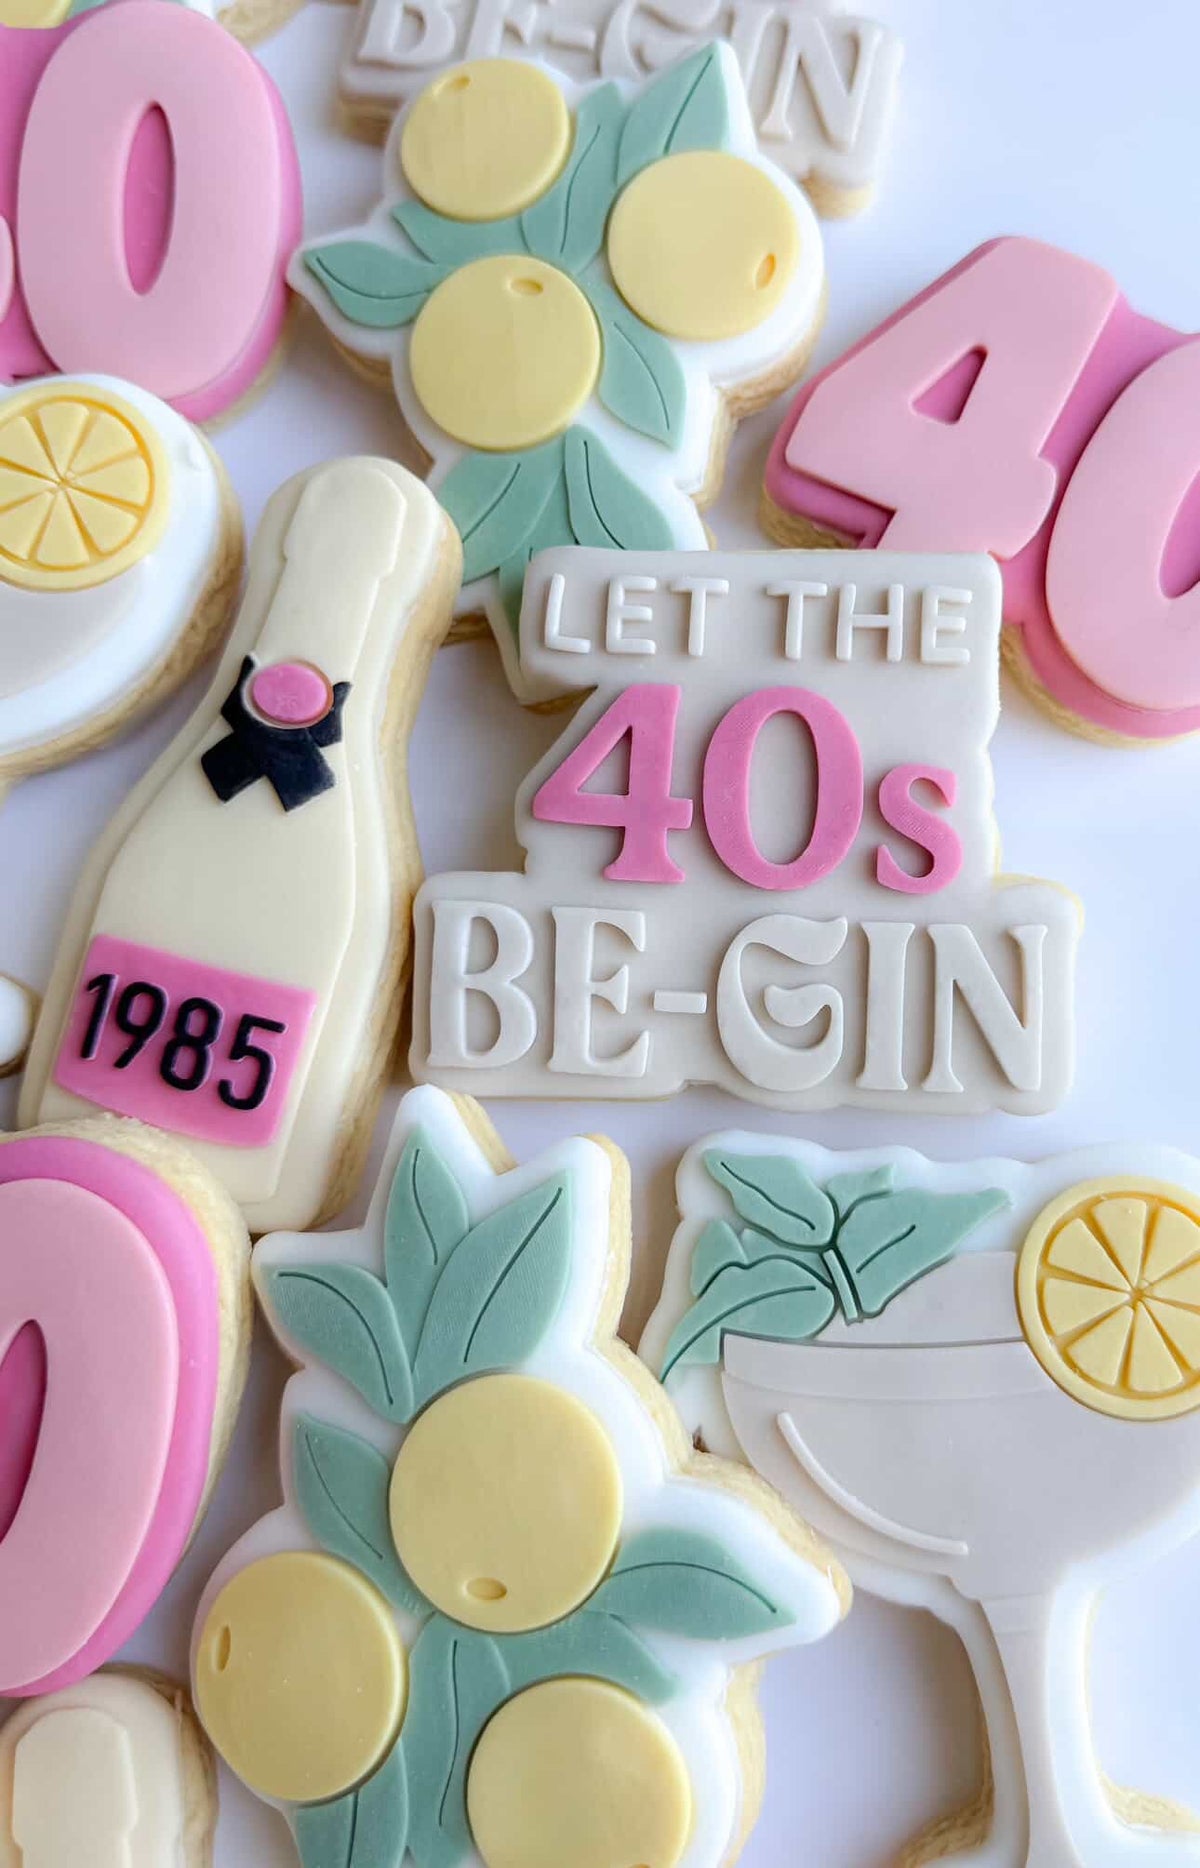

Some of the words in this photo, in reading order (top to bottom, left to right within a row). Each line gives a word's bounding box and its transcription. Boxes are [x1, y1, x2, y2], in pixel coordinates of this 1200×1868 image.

[545, 573, 730, 657] LET
[766, 582, 973, 665] THE
[532, 683, 963, 894] 40s
[80, 973, 287, 1111] 1985
[427, 901, 1048, 1092] BE-GIN
